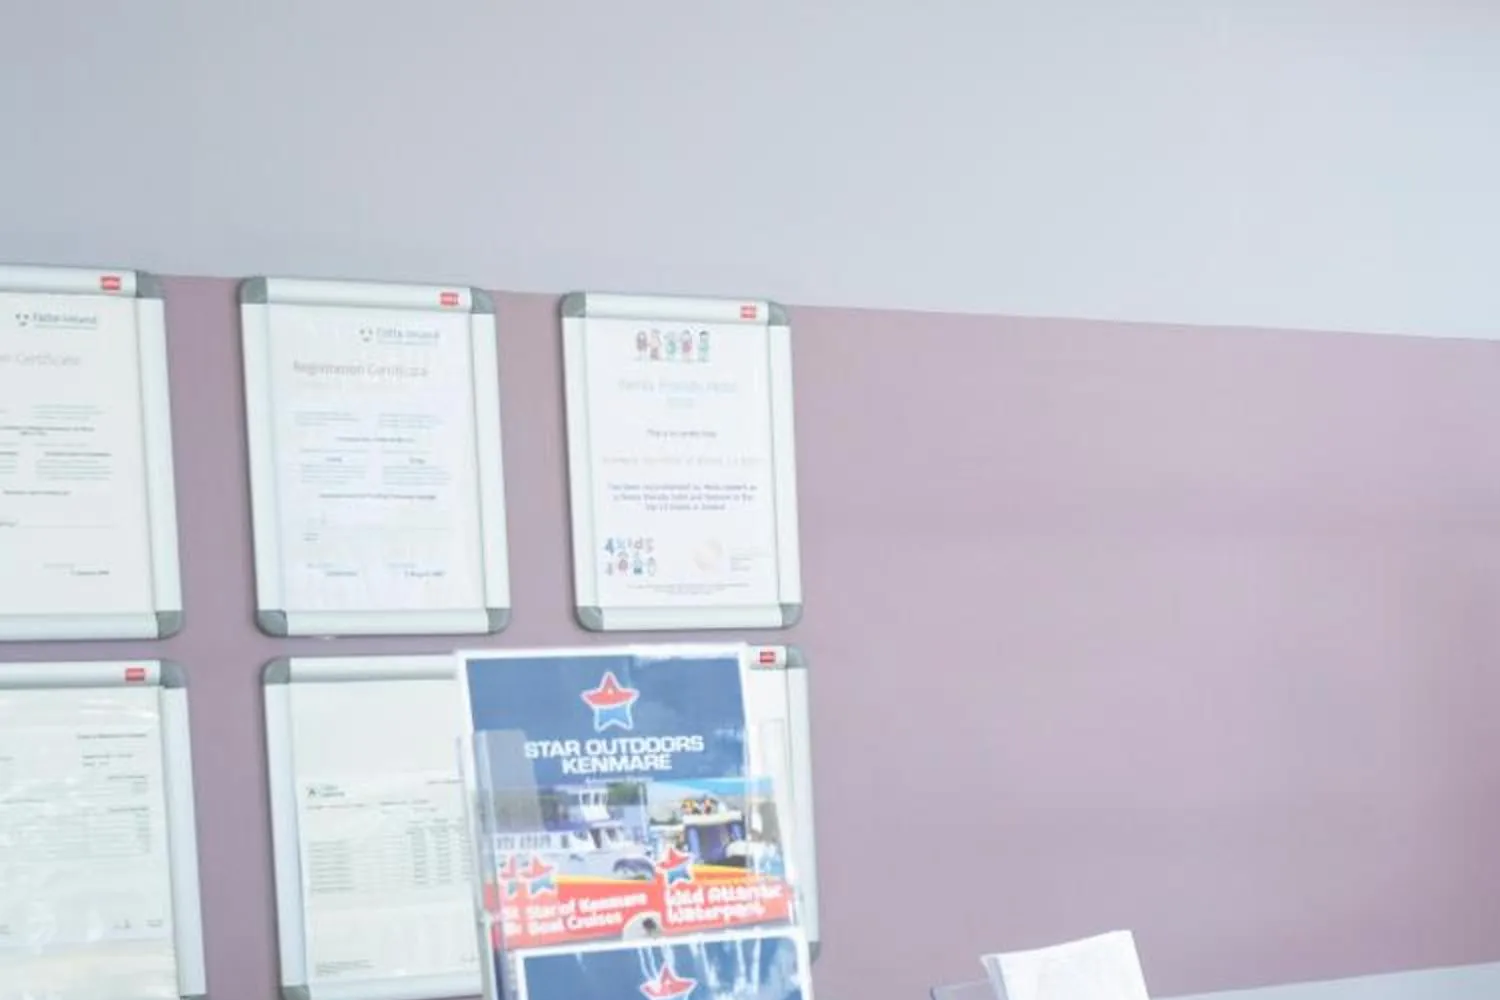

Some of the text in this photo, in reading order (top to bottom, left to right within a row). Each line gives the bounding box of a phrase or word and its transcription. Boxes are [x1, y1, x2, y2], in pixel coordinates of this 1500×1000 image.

[523, 735, 705, 760] STAR OUTDOORS
[561, 752, 673, 775] KENMARE
